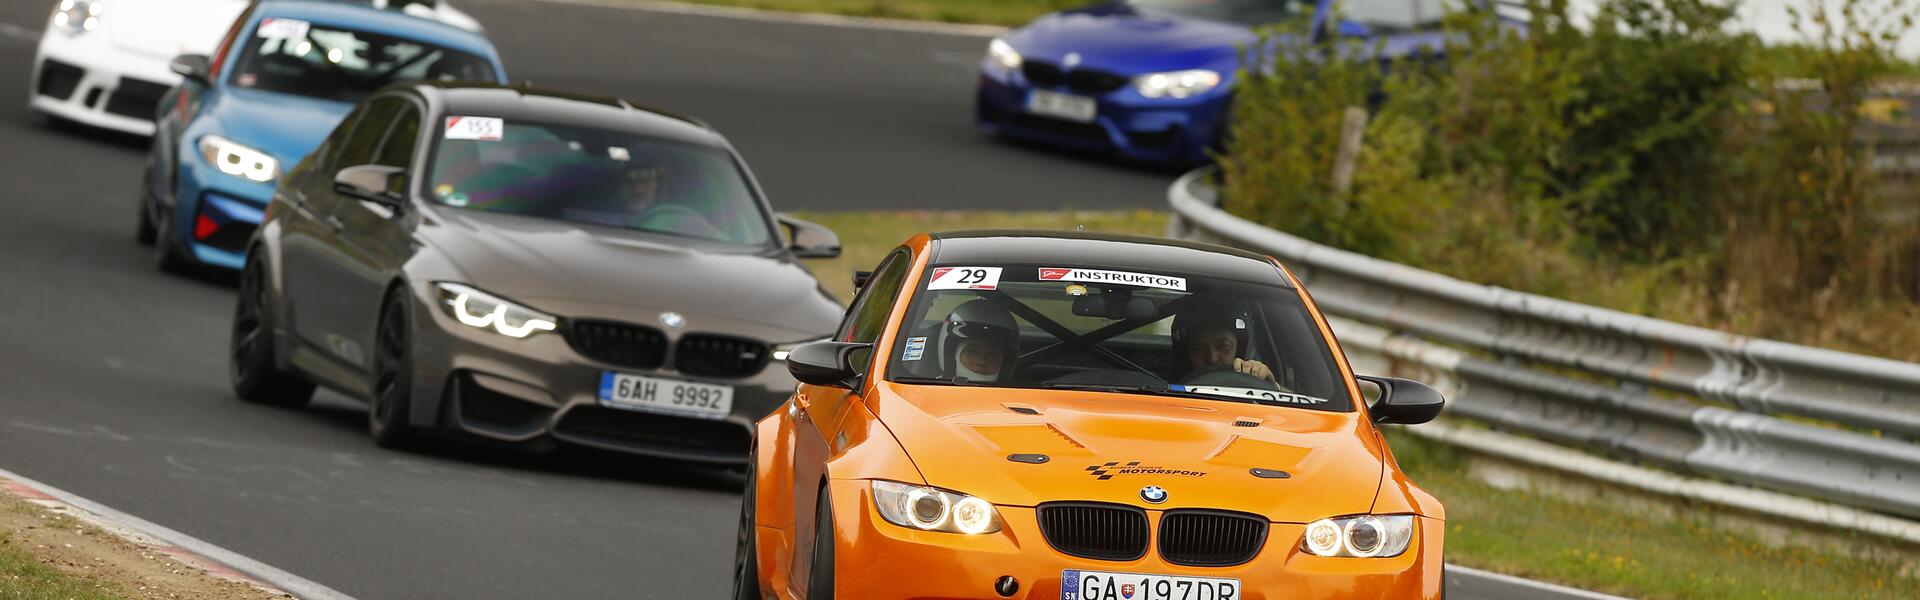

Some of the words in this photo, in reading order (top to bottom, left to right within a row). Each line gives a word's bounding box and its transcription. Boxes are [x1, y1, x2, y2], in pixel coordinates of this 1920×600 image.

[467, 119, 493, 134] 155
[956, 268, 988, 284] 29
[1073, 270, 1180, 287] INSTRUKTOR
[618, 378, 658, 401] 6AH
[672, 384, 723, 409] 9992
[1119, 468, 1207, 477] MOTORSPORT
[1082, 574, 1118, 600] GA
[1140, 578, 1235, 600] 197DR
